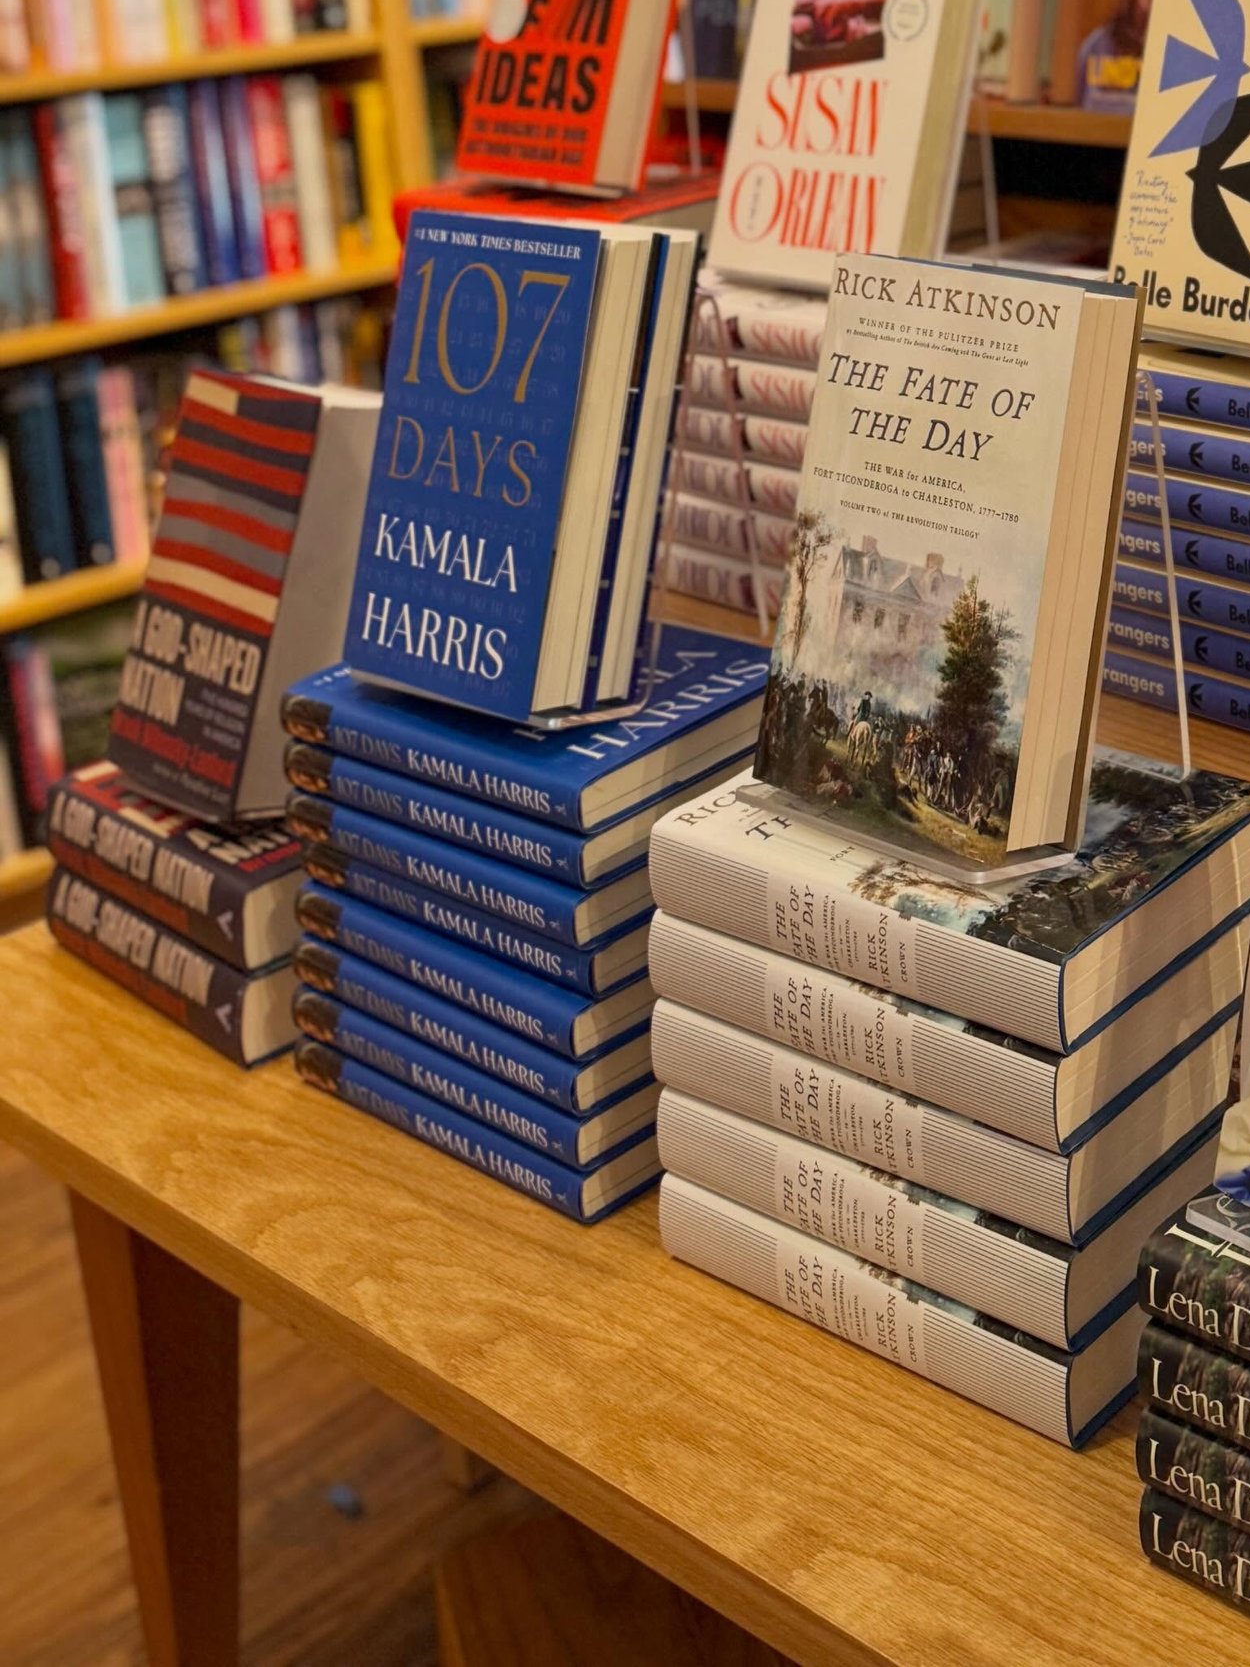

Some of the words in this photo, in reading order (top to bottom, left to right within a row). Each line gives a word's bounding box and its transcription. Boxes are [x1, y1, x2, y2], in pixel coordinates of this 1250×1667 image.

[476, 50, 603, 114] IDEAS
[756, 73, 888, 157] SUSAN
[730, 162, 887, 254] ORLEAN
[427, 229, 448, 242] NEW
[450, 232, 478, 247] YORK
[480, 235, 512, 251] TIMES
[513, 240, 582, 261] BESTSELLER
[402, 256, 571, 404] 107
[835, 268, 896, 303] RICK
[906, 279, 1060, 330] ATKINSON
[859, 317, 896, 332] WINNER
[899, 324, 912, 334] OF
[916, 327, 934, 338] THE
[938, 331, 985, 347] PULITZER
[989, 340, 1020, 353] PRIZE
[828, 352, 889, 391] THE
[898, 365, 978, 410] FATE
[991, 388, 1036, 420] OF
[388, 415, 538, 508] DAYS
[848, 407, 912, 444] THE
[922, 419, 995, 462] DAY
[814, 467, 834, 479] FORT
[836, 472, 899, 495] TICONDEROGA
[901, 488, 910, 498] to
[913, 490, 976, 514] CHARLESTON,
[864, 461, 882, 473] THE
[886, 465, 904, 478] WAR
[906, 470, 919, 481] for
[922, 475, 966, 493] AMERICA,
[840, 500, 865, 511] VOLUME
[866, 505, 881, 515] TWO
[891, 512, 904, 521] THE
[906, 515, 948, 532] REVOLUTION
[950, 526, 980, 539] TRILOGY
[374, 513, 518, 593] KAMALA
[361, 592, 507, 681] HARRIS
[566, 649, 769, 760] HARRIS
[407, 749, 481, 791] KAMALA
[484, 773, 551, 814] HARRIS
[409, 800, 483, 845] KAMALA
[486, 826, 552, 867] HARRIS
[775, 901, 788, 941] THE
[802, 885, 815, 927] DAY
[868, 933, 878, 971] RICK
[900, 942, 909, 983] CROWN
[1148, 1266, 1221, 1338] Lena
[1151, 1358, 1226, 1431] Lena
[1149, 1439, 1223, 1513] Lena
